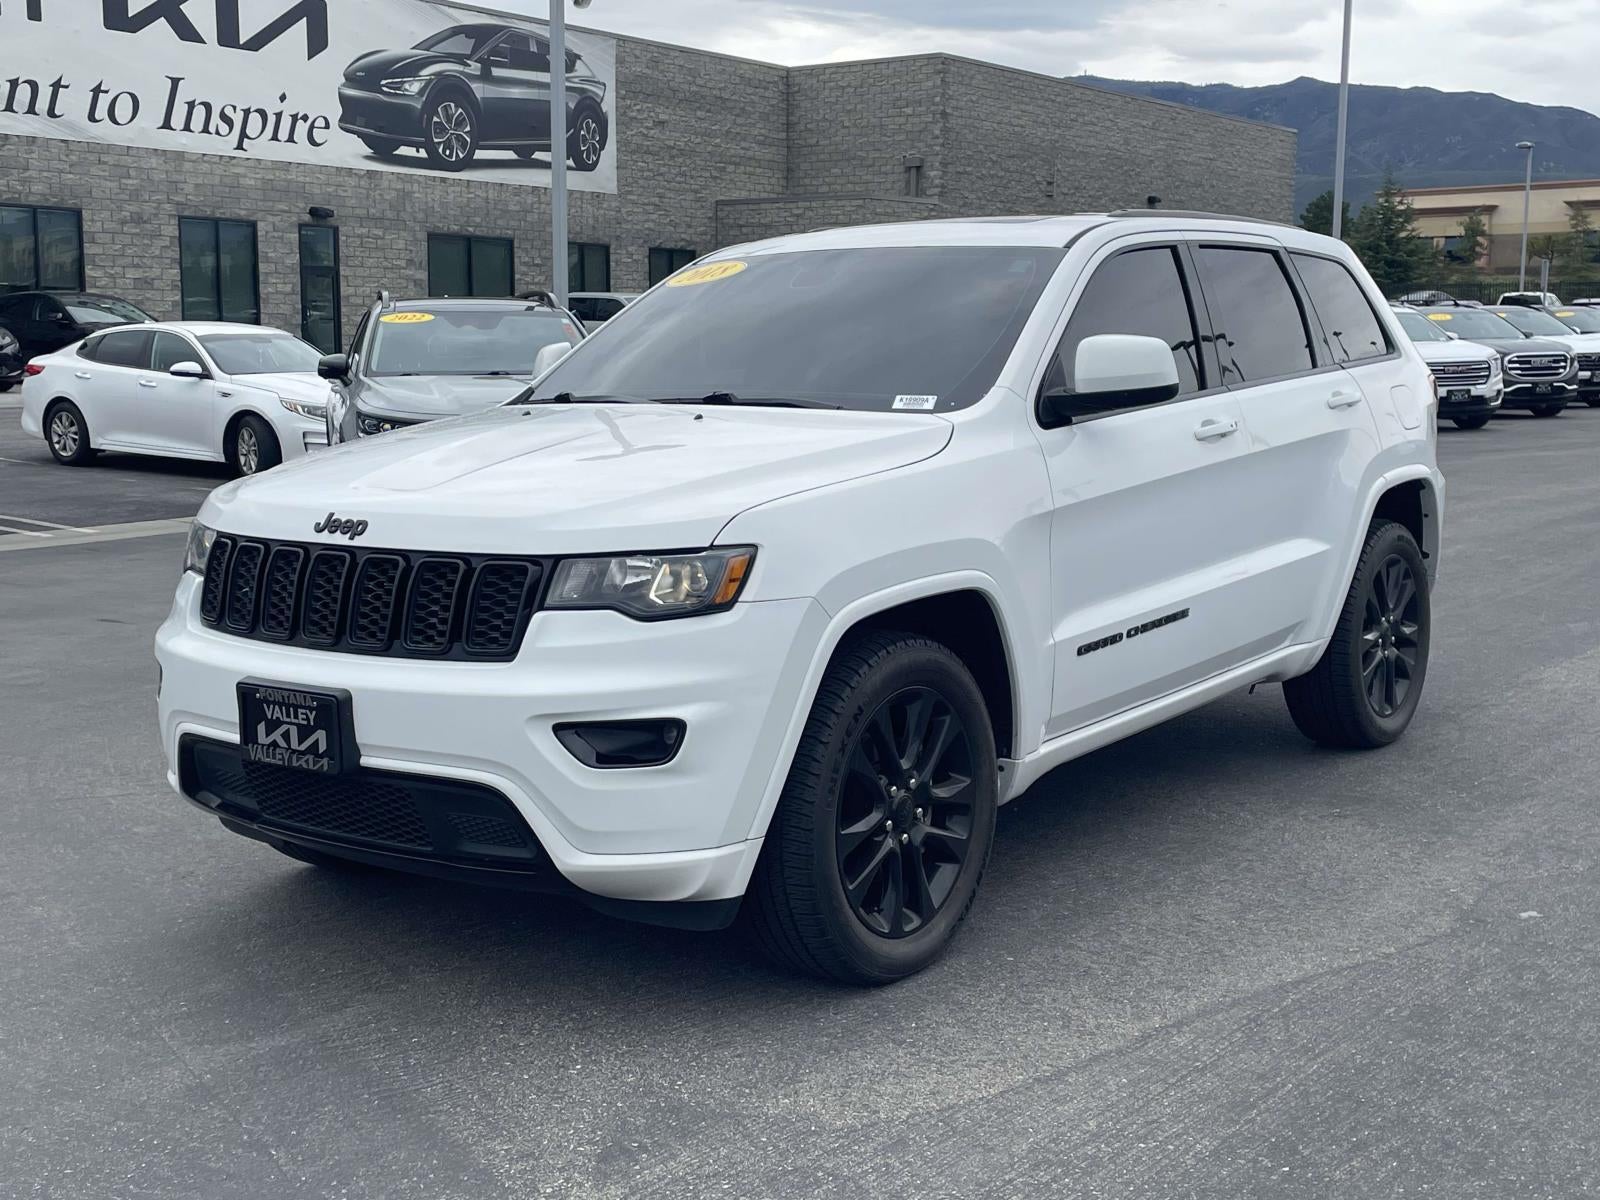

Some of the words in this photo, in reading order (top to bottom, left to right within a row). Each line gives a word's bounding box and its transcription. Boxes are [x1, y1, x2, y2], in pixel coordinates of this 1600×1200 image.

[0, 74, 70, 119] nt
[86, 80, 140, 126] to
[157, 75, 330, 151] Inspire
[313, 511, 369, 540] Jeep
[263, 703, 316, 726] VALLEY
[257, 720, 327, 754] KIA
[248, 743, 292, 767] VALLEY
